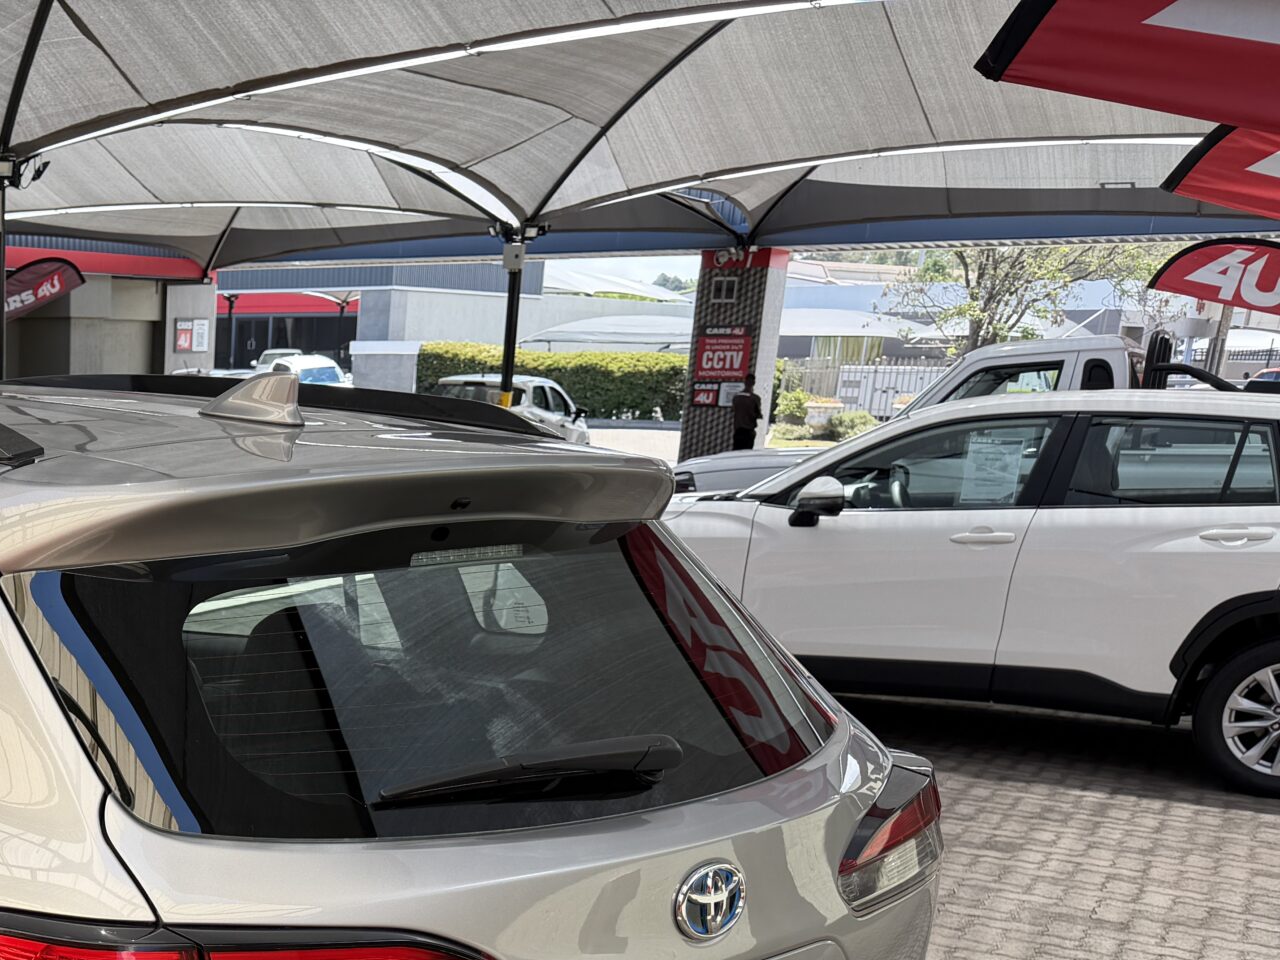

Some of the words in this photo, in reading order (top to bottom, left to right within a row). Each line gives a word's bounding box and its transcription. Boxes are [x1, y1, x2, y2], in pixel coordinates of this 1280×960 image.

[37, 274, 61, 298] 4U
[1183, 248, 1280, 307] 4U
[705, 327, 732, 335] CARS
[733, 327, 746, 335] 4U
[702, 350, 744, 369] CCTV
[695, 392, 714, 404] 4U
